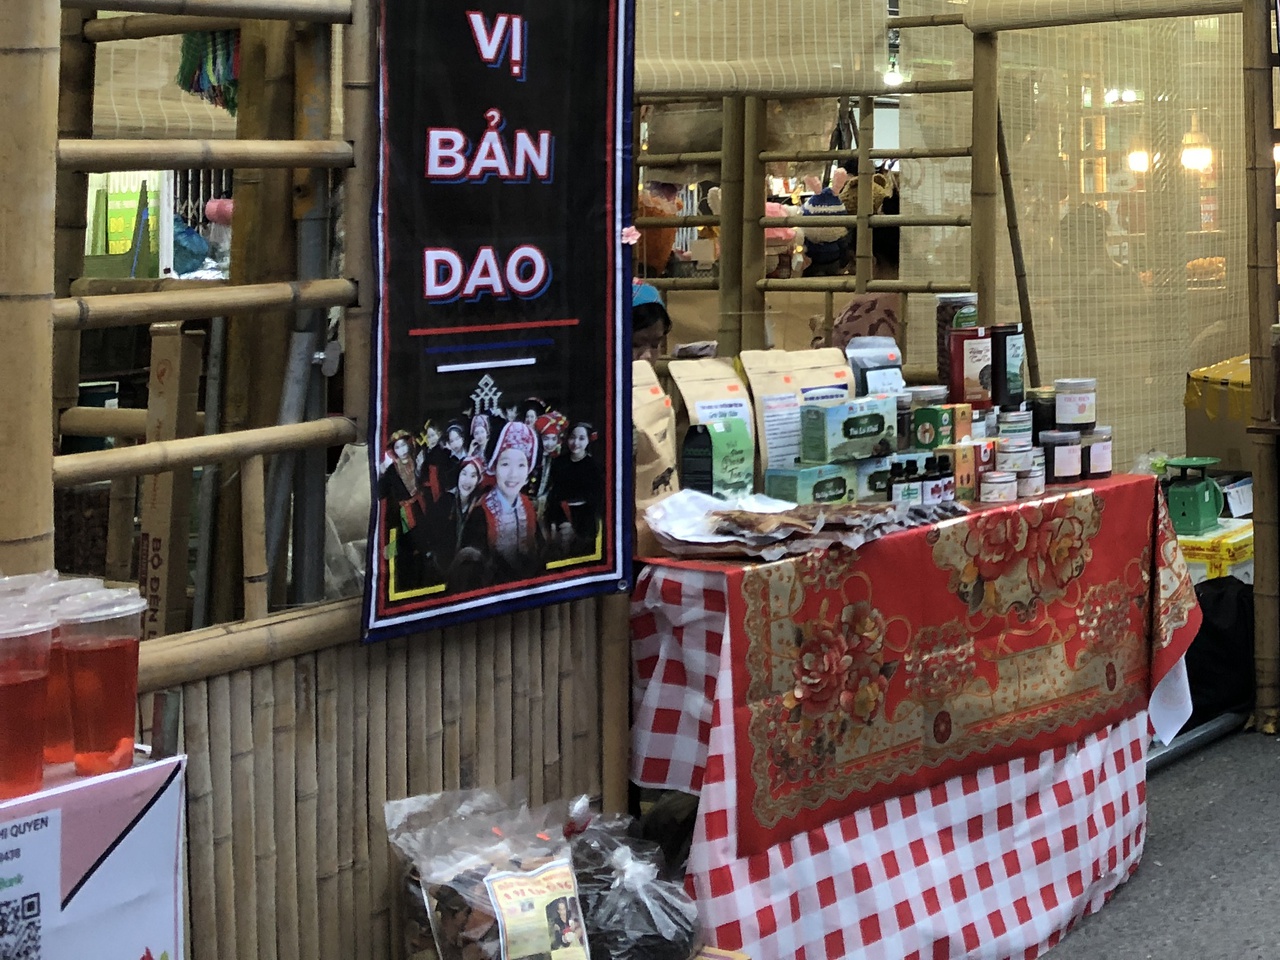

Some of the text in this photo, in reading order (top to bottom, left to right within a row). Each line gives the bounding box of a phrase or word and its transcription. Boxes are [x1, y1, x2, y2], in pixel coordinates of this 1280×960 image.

[465, 10, 527, 81] VỊ
[426, 107, 553, 182] BẢN
[423, 244, 552, 302] DAO
[149, 536, 163, 571] BỘ
[10, 816, 49, 838] QUYEN
